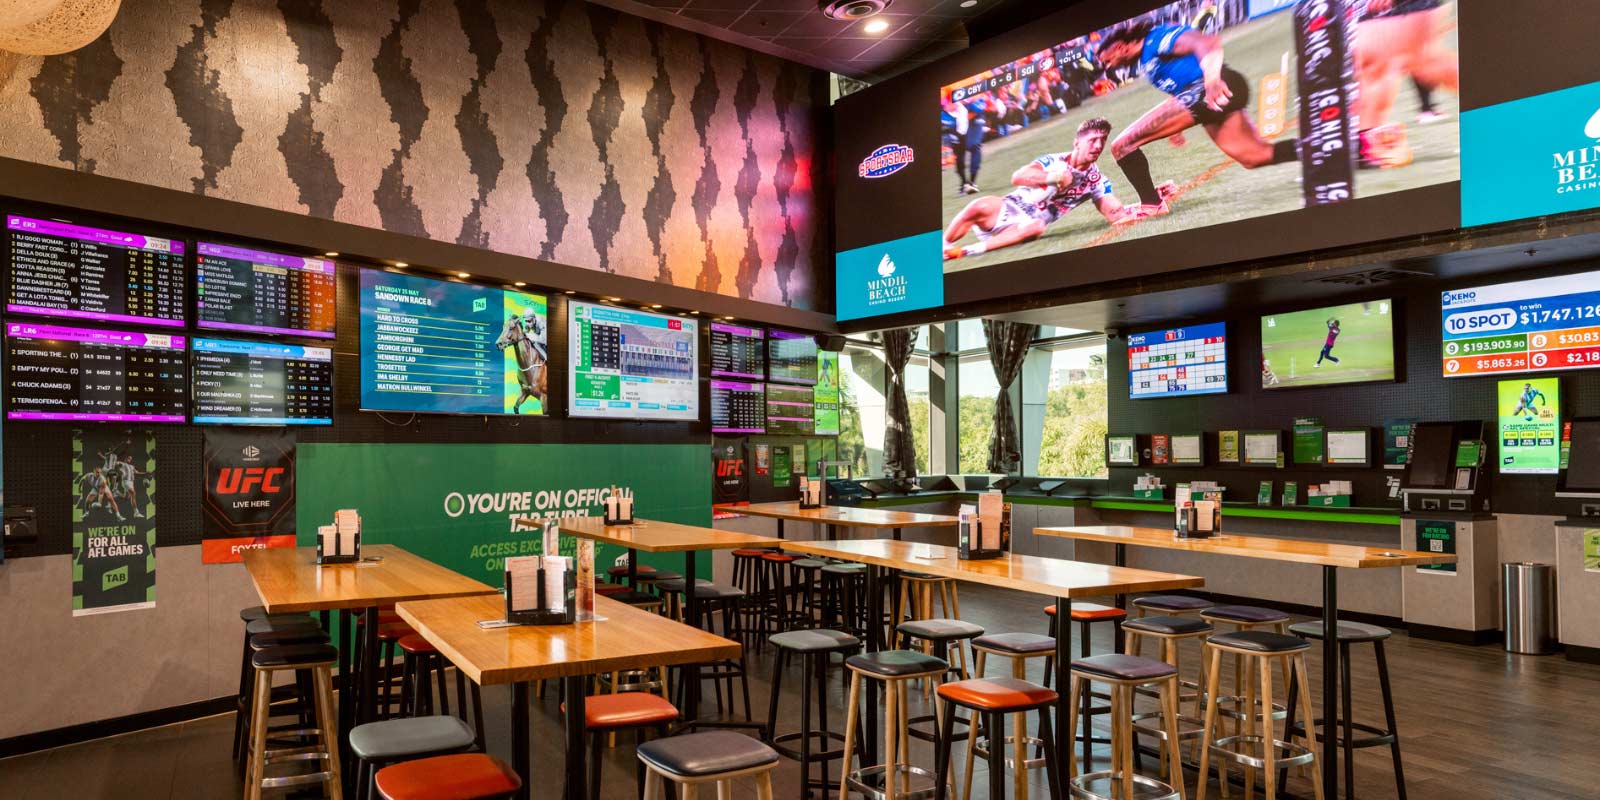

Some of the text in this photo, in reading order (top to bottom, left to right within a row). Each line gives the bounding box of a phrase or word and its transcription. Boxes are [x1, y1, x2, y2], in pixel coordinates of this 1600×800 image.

[968, 83, 982, 96] CBY
[990, 78, 996, 87] 6
[1006, 73, 1012, 81] 6
[1021, 65, 1034, 77] SGI
[859, 148, 914, 177] SPORTSBAR
[1557, 182, 1600, 193] CASIN
[375, 285, 401, 293] SATURDAY
[868, 275, 908, 290] MINDIL
[375, 292, 409, 303] SANDOWN
[410, 296, 426, 305] RACE
[869, 286, 905, 300] BEACH
[1452, 292, 1476, 300] KENO
[1450, 313, 1510, 330] 10 SPOT
[377, 334, 414, 343] ZAMBORGHINI
[717, 459, 744, 477] UFC
[216, 467, 284, 494] UFC
[467, 492, 532, 514] YOU'RE
[535, 490, 561, 510] ON
[564, 487, 630, 508] OFFIC
[509, 512, 541, 532] TAB
[88, 525, 136, 537] WE'RE ON
[88, 536, 128, 548] FOR ALL
[470, 541, 516, 558] ACCESS
[520, 537, 576, 553] EXCIVE
[88, 544, 144, 558] AFL GAMES
[106, 574, 126, 582] TAB
